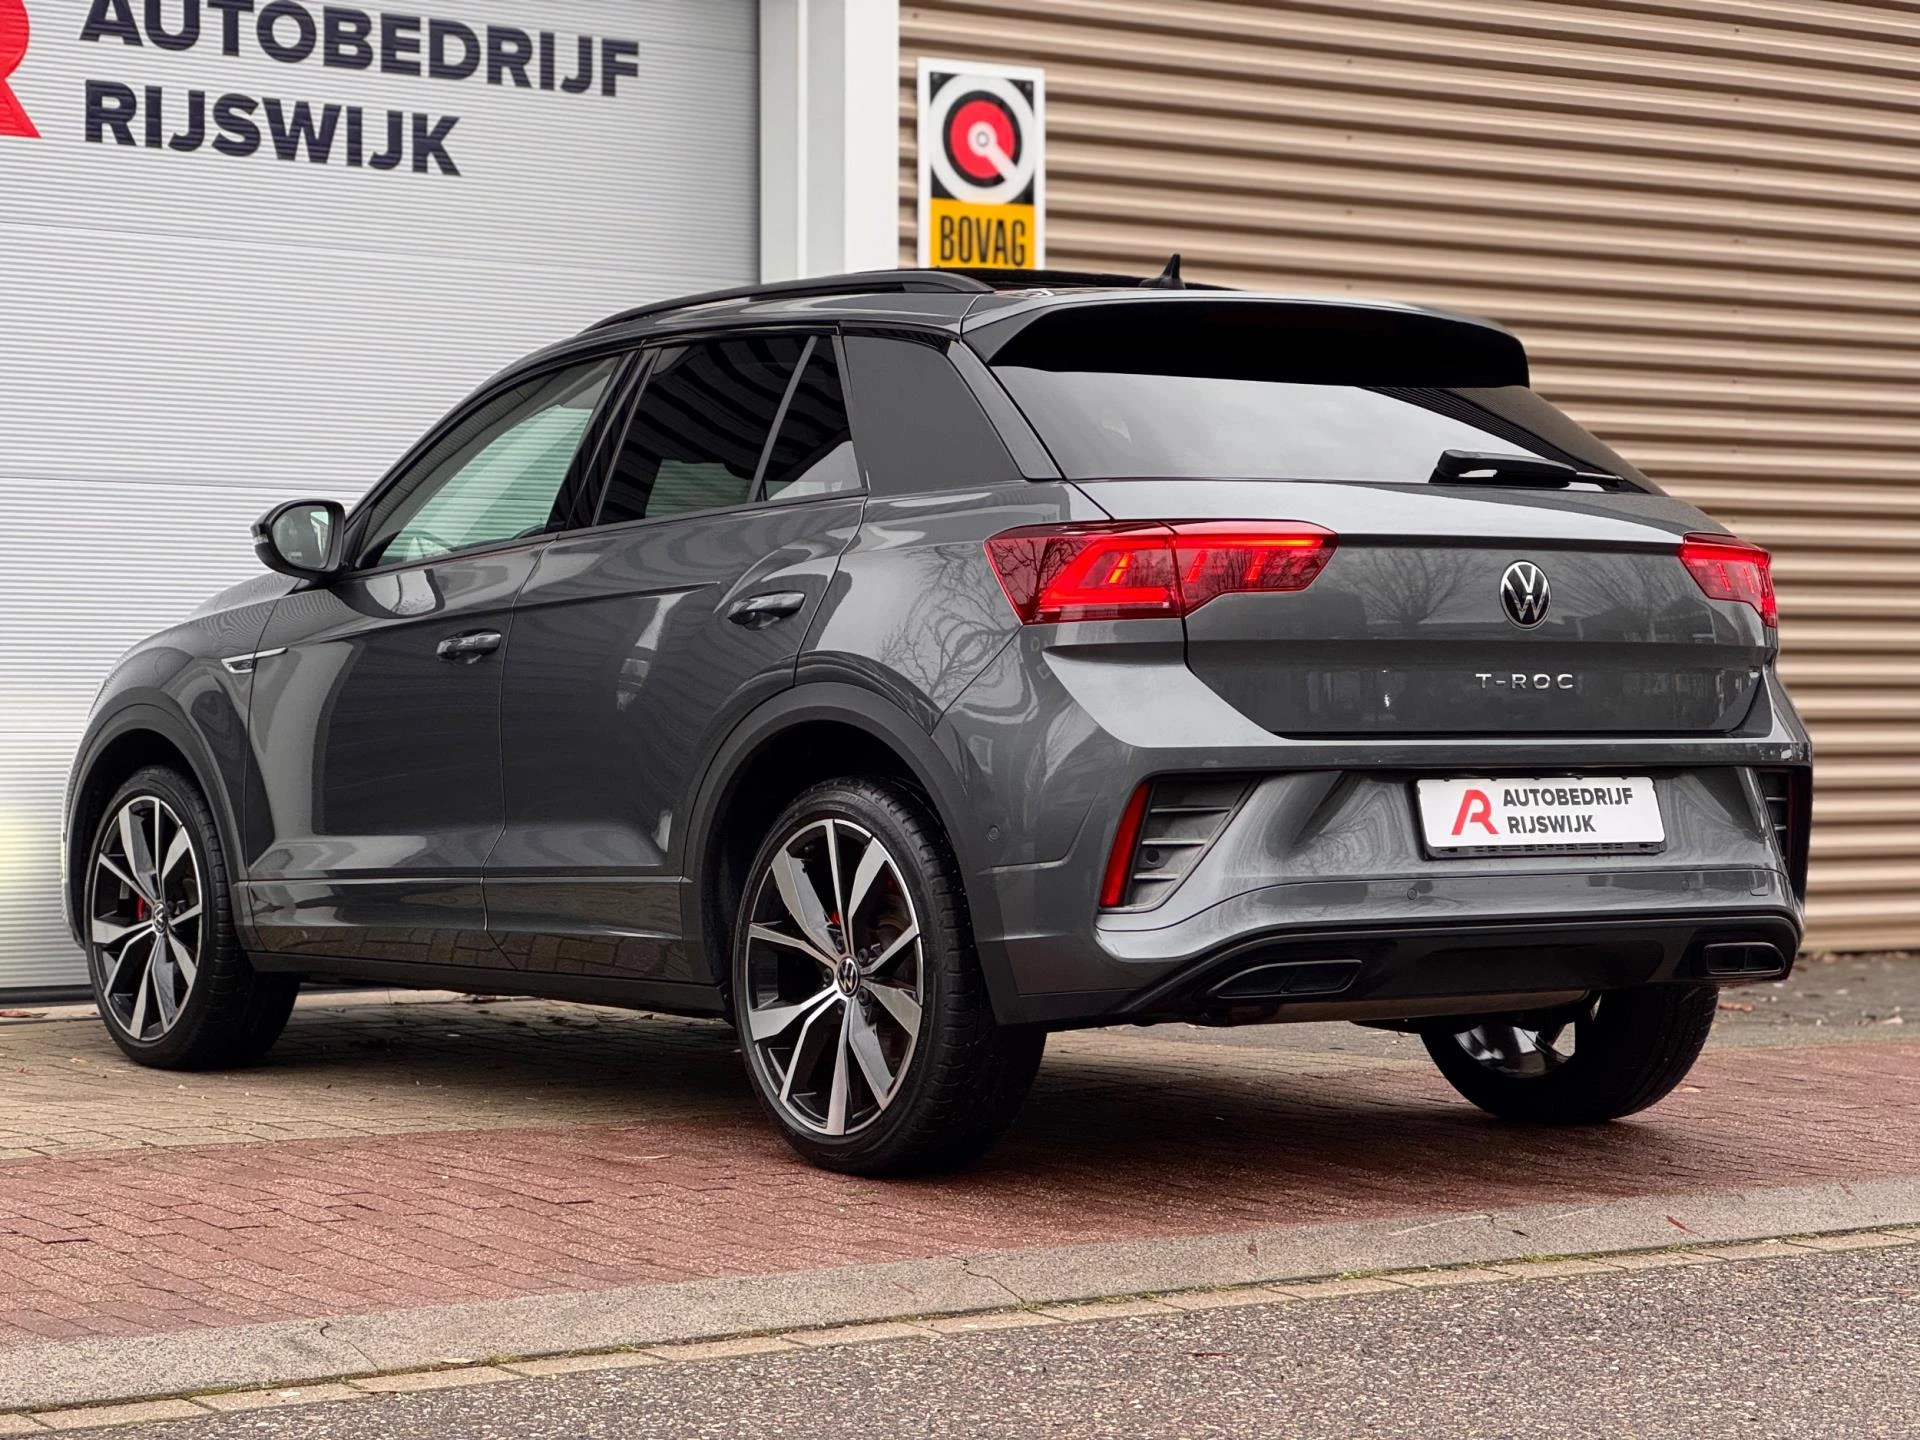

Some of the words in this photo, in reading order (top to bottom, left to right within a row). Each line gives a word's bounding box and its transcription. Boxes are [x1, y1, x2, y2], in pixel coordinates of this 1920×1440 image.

[79, 0, 640, 98] AUTOBEDRIJF
[84, 79, 462, 177] RIJSWIJK
[940, 215, 1026, 267] BOVAG
[1475, 673, 1574, 690] T-ROC
[1503, 787, 1633, 807] AUTOBEDRIJF
[1507, 815, 1597, 834] RIJSWIJK
